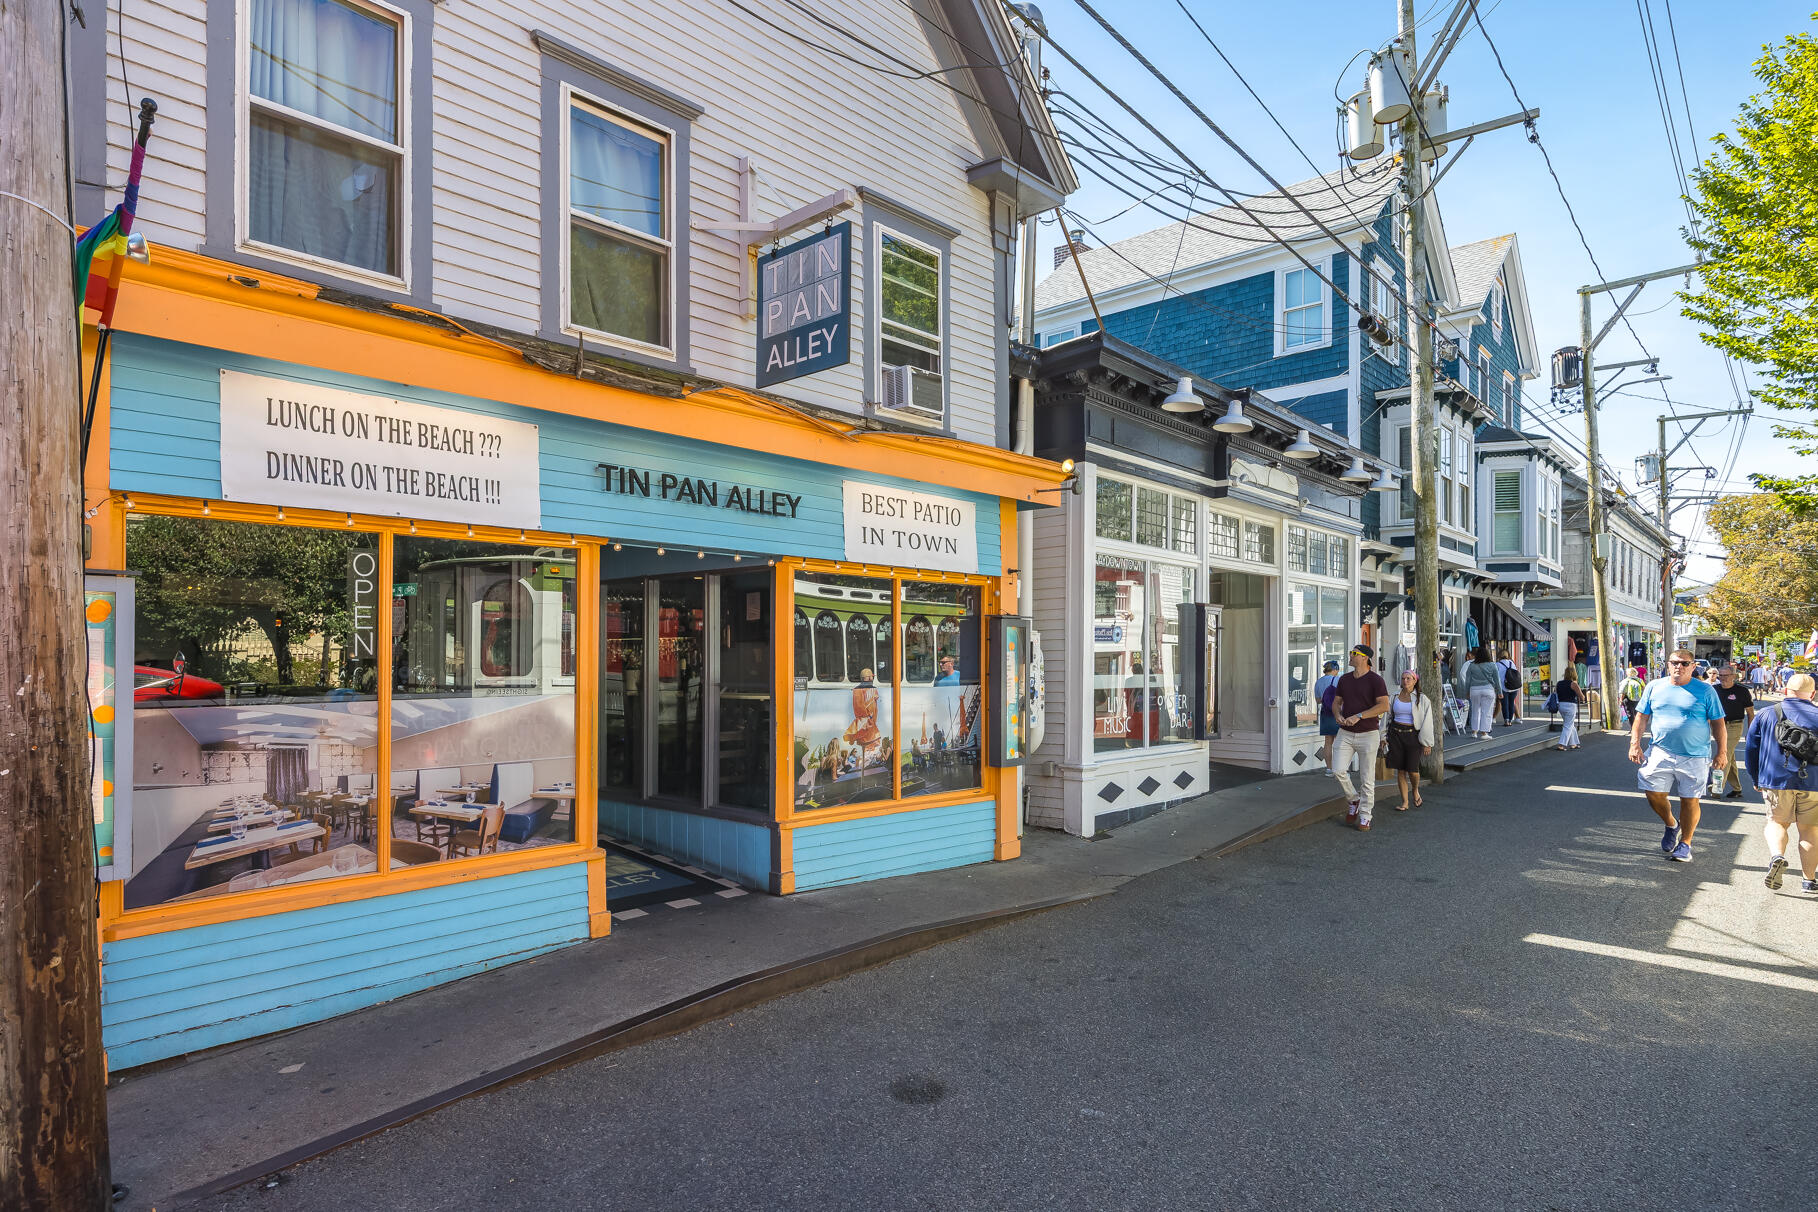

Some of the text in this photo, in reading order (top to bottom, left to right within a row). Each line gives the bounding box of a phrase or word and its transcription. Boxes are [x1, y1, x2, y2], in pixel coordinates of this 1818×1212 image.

[766, 237, 839, 294] TIN
[768, 278, 839, 334] PAN
[765, 323, 839, 373] ALLEY
[266, 397, 502, 458] LUNCH ON THE BEACH ???
[266, 450, 501, 505] DINNER ON THE BEACH !!!
[598, 463, 802, 519] TIN PAN ALLEY
[861, 492, 962, 527] BEST PATIO
[861, 526, 958, 554] IN TOWN
[352, 552, 376, 658] OPEN
[1103, 716, 1132, 734] MUSIC
[1170, 713, 1188, 729] BAR
[607, 871, 661, 888] LEY
